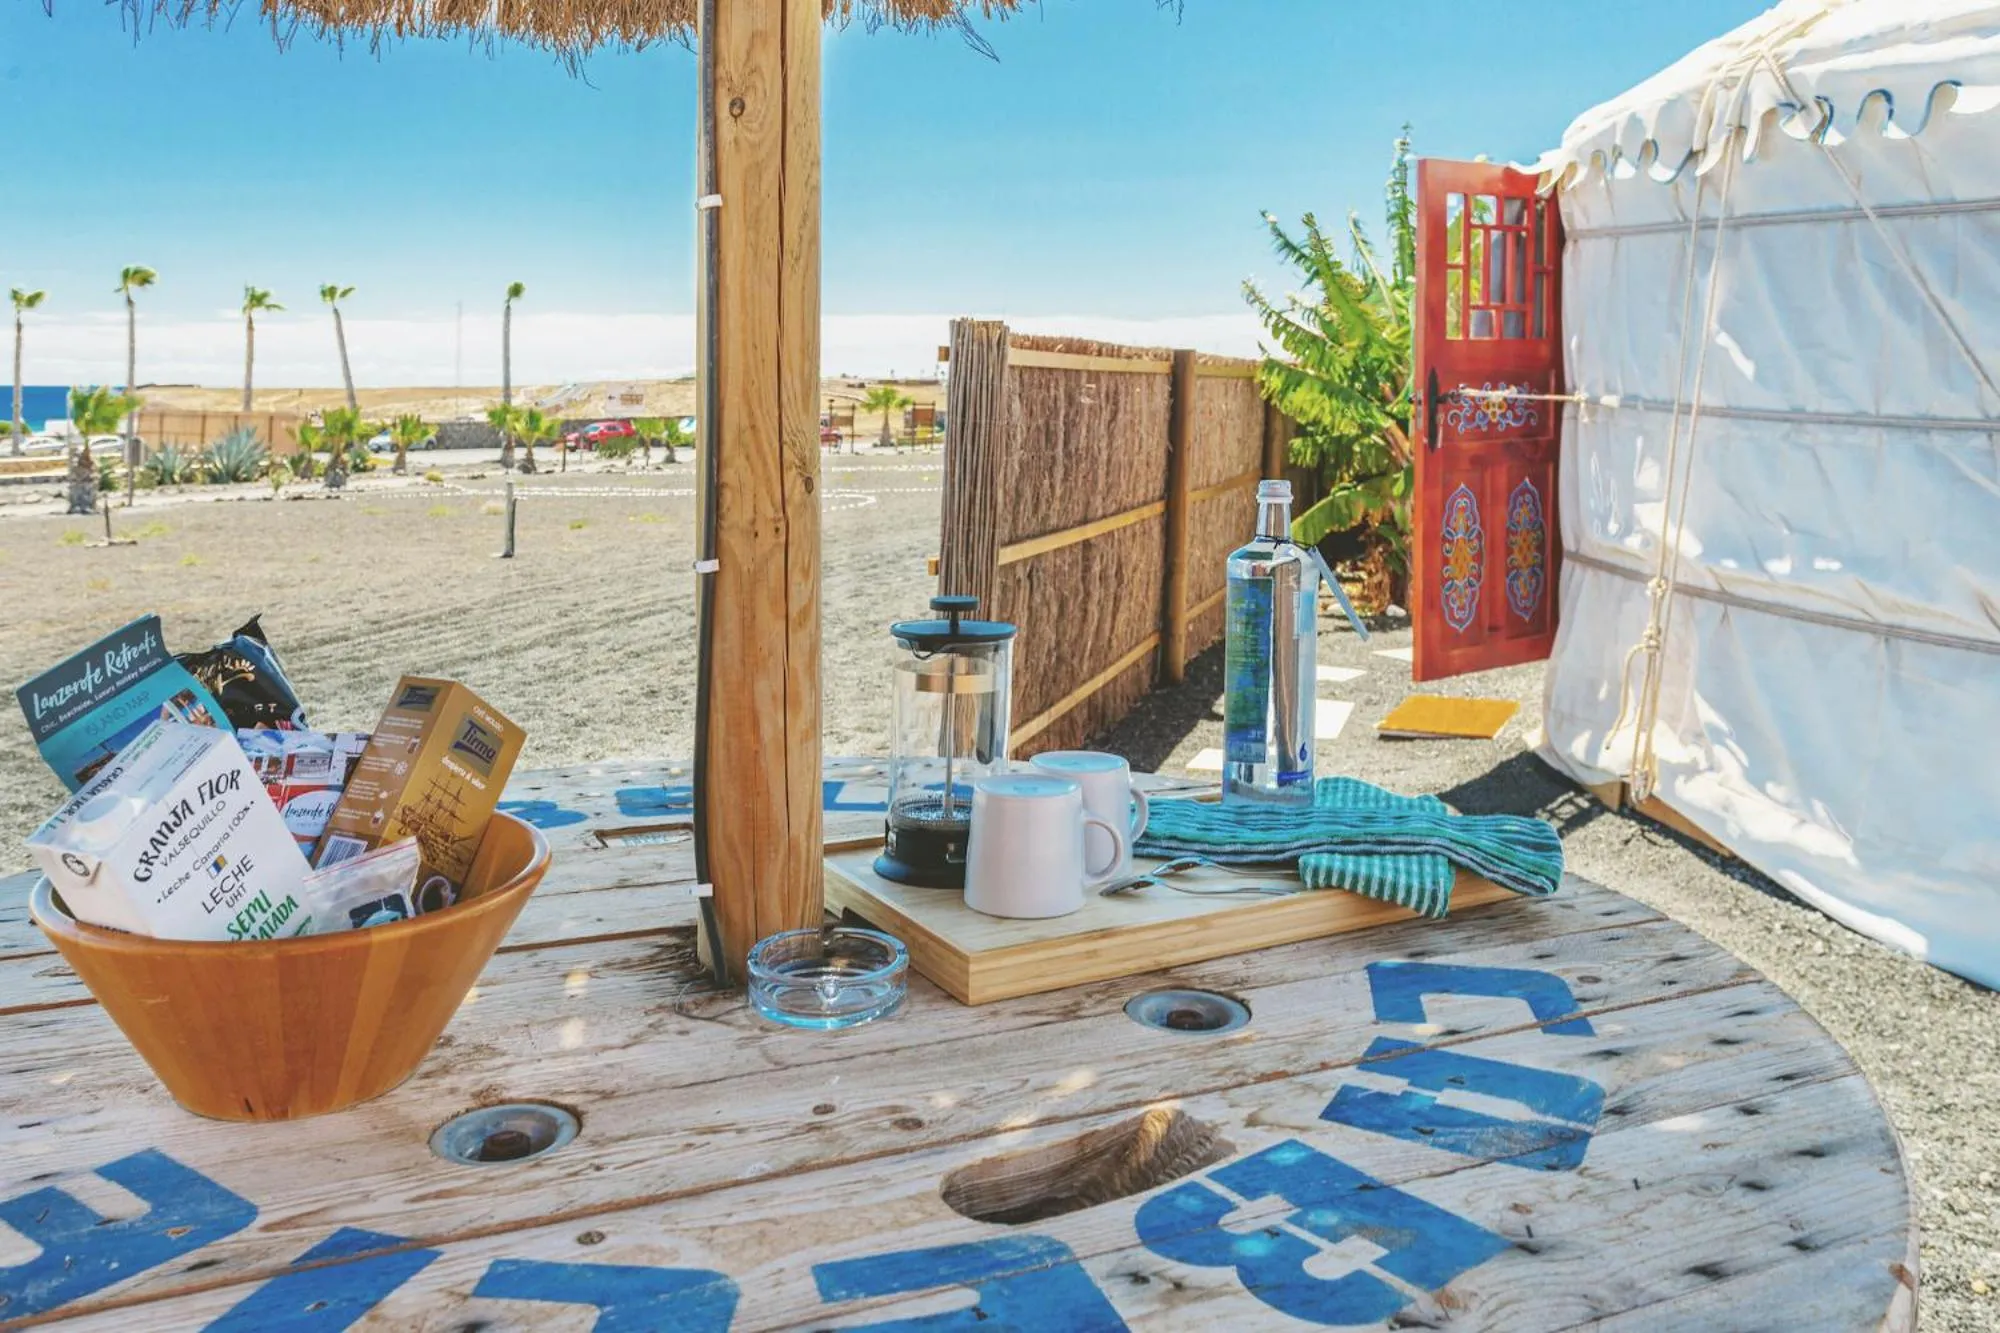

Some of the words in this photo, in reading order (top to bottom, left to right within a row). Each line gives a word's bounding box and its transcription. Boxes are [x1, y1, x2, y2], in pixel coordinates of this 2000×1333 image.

[33, 661, 104, 720] Lanzarote
[104, 631, 157, 677] Retreats
[133, 797, 195, 883] GRANJA
[160, 800, 227, 868] VALSEQUILLO
[162, 873, 192, 900] Leche
[192, 832, 230, 871] Canaria
[201, 854, 255, 915] LECHE
[224, 882, 248, 909] UHT
[226, 888, 272, 941] SEMI
